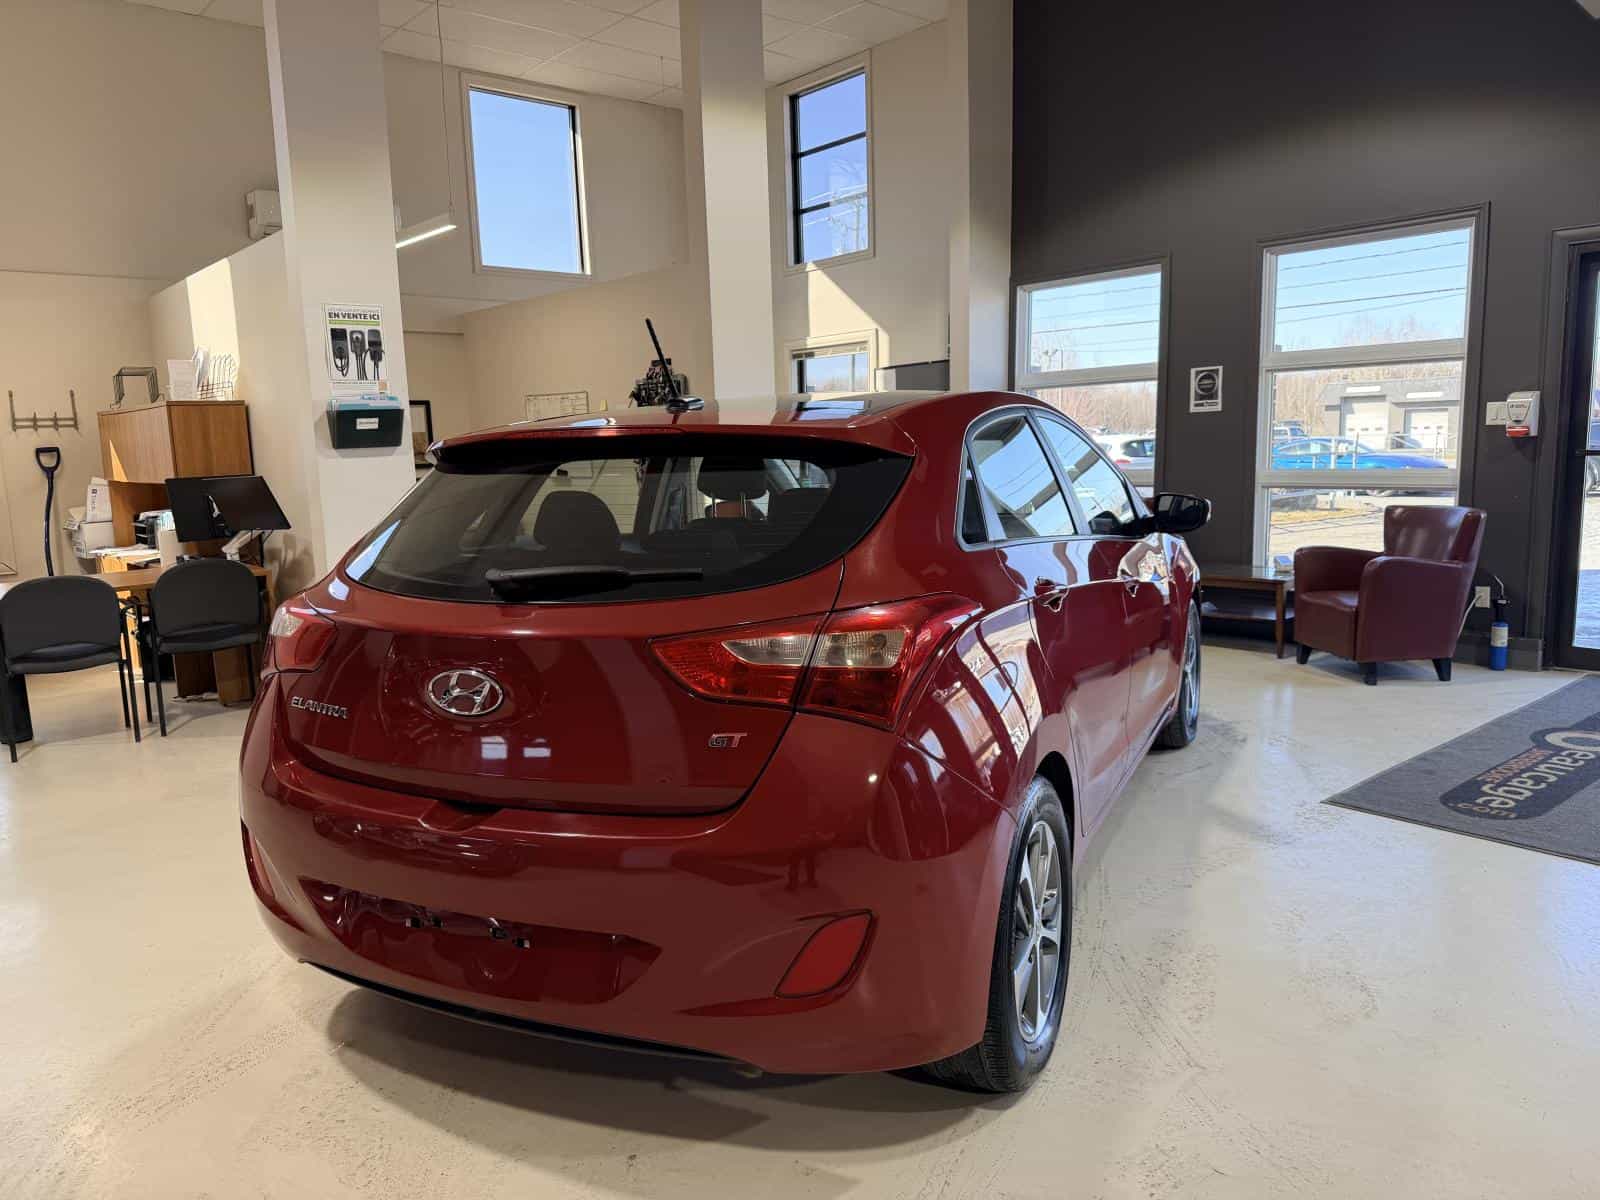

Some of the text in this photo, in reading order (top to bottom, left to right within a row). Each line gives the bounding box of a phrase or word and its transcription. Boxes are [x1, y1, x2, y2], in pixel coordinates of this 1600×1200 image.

[328, 311, 340, 319] EN
[341, 312, 368, 320] VENTE
[291, 696, 348, 719] ELANTRA
[708, 732, 748, 748] GT
